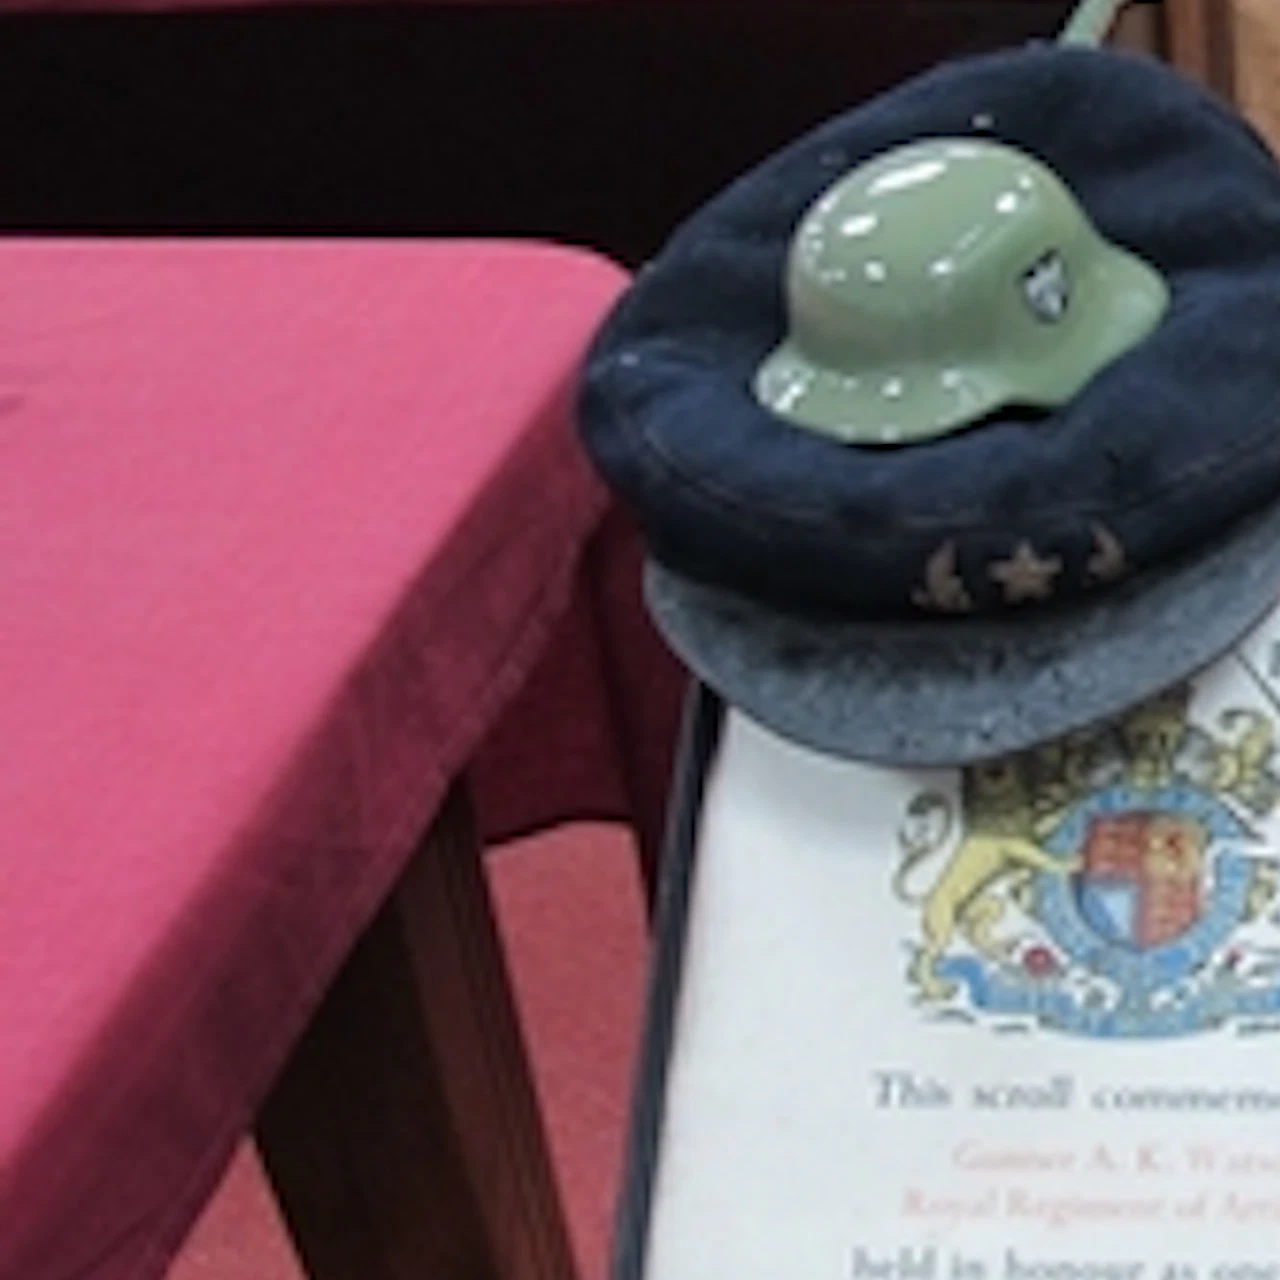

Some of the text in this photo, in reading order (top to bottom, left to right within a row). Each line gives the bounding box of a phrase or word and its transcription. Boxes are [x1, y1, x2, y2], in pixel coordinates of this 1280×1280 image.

[874, 1071, 953, 1109] This
[971, 1075, 1074, 1110] scroll
[1173, 1192, 1208, 1221] of
